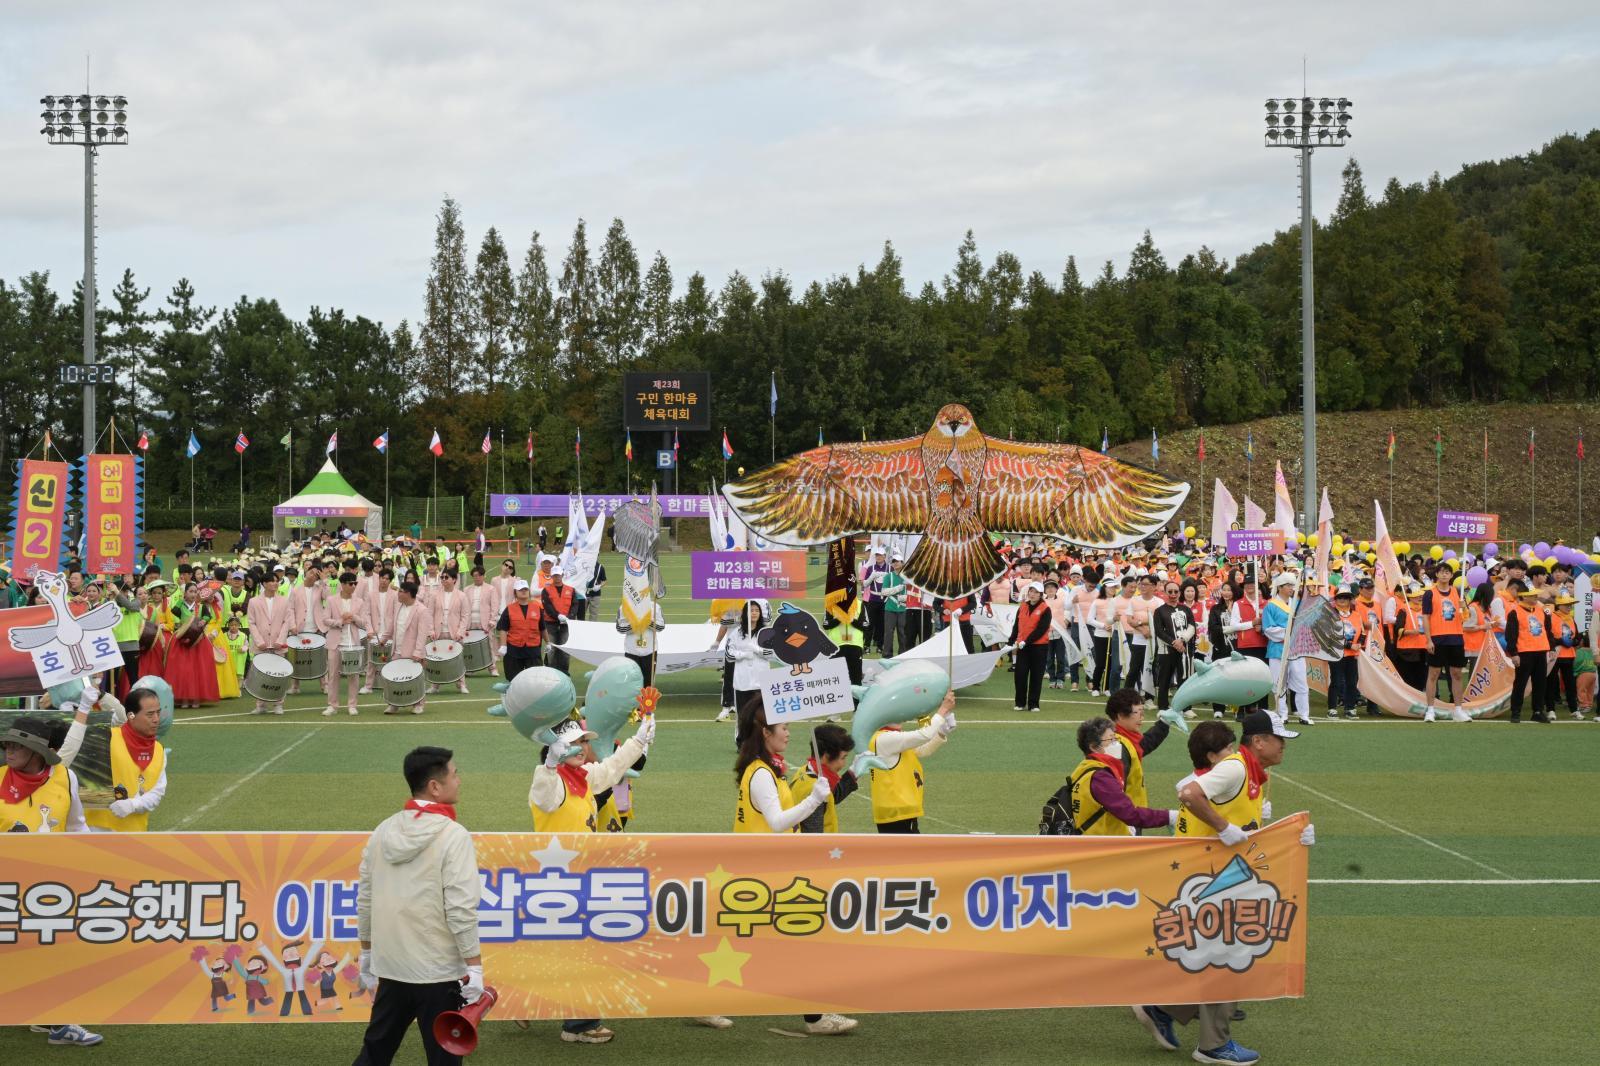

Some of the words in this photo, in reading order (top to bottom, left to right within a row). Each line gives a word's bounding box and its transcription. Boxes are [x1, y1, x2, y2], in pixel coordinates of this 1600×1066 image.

[60, 365, 114, 383] 10:22
[652, 379, 681, 390] 제23회
[635, 392, 659, 405] 구민
[663, 392, 698, 405] 한마음
[643, 408, 690, 420] 체육대회
[659, 452, 672, 467] B
[1448, 521, 1486, 535] 신정3동
[1238, 540, 1273, 551] 신정1동
[713, 561, 754, 574] 제23회
[758, 561, 782, 574] 구민
[706, 577, 790, 590] 한마음체육대회
[770, 679, 805, 696] 삼호동
[716, 876, 950, 938] 우승이닷.
[1153, 896, 1297, 952] 화이팅!!
